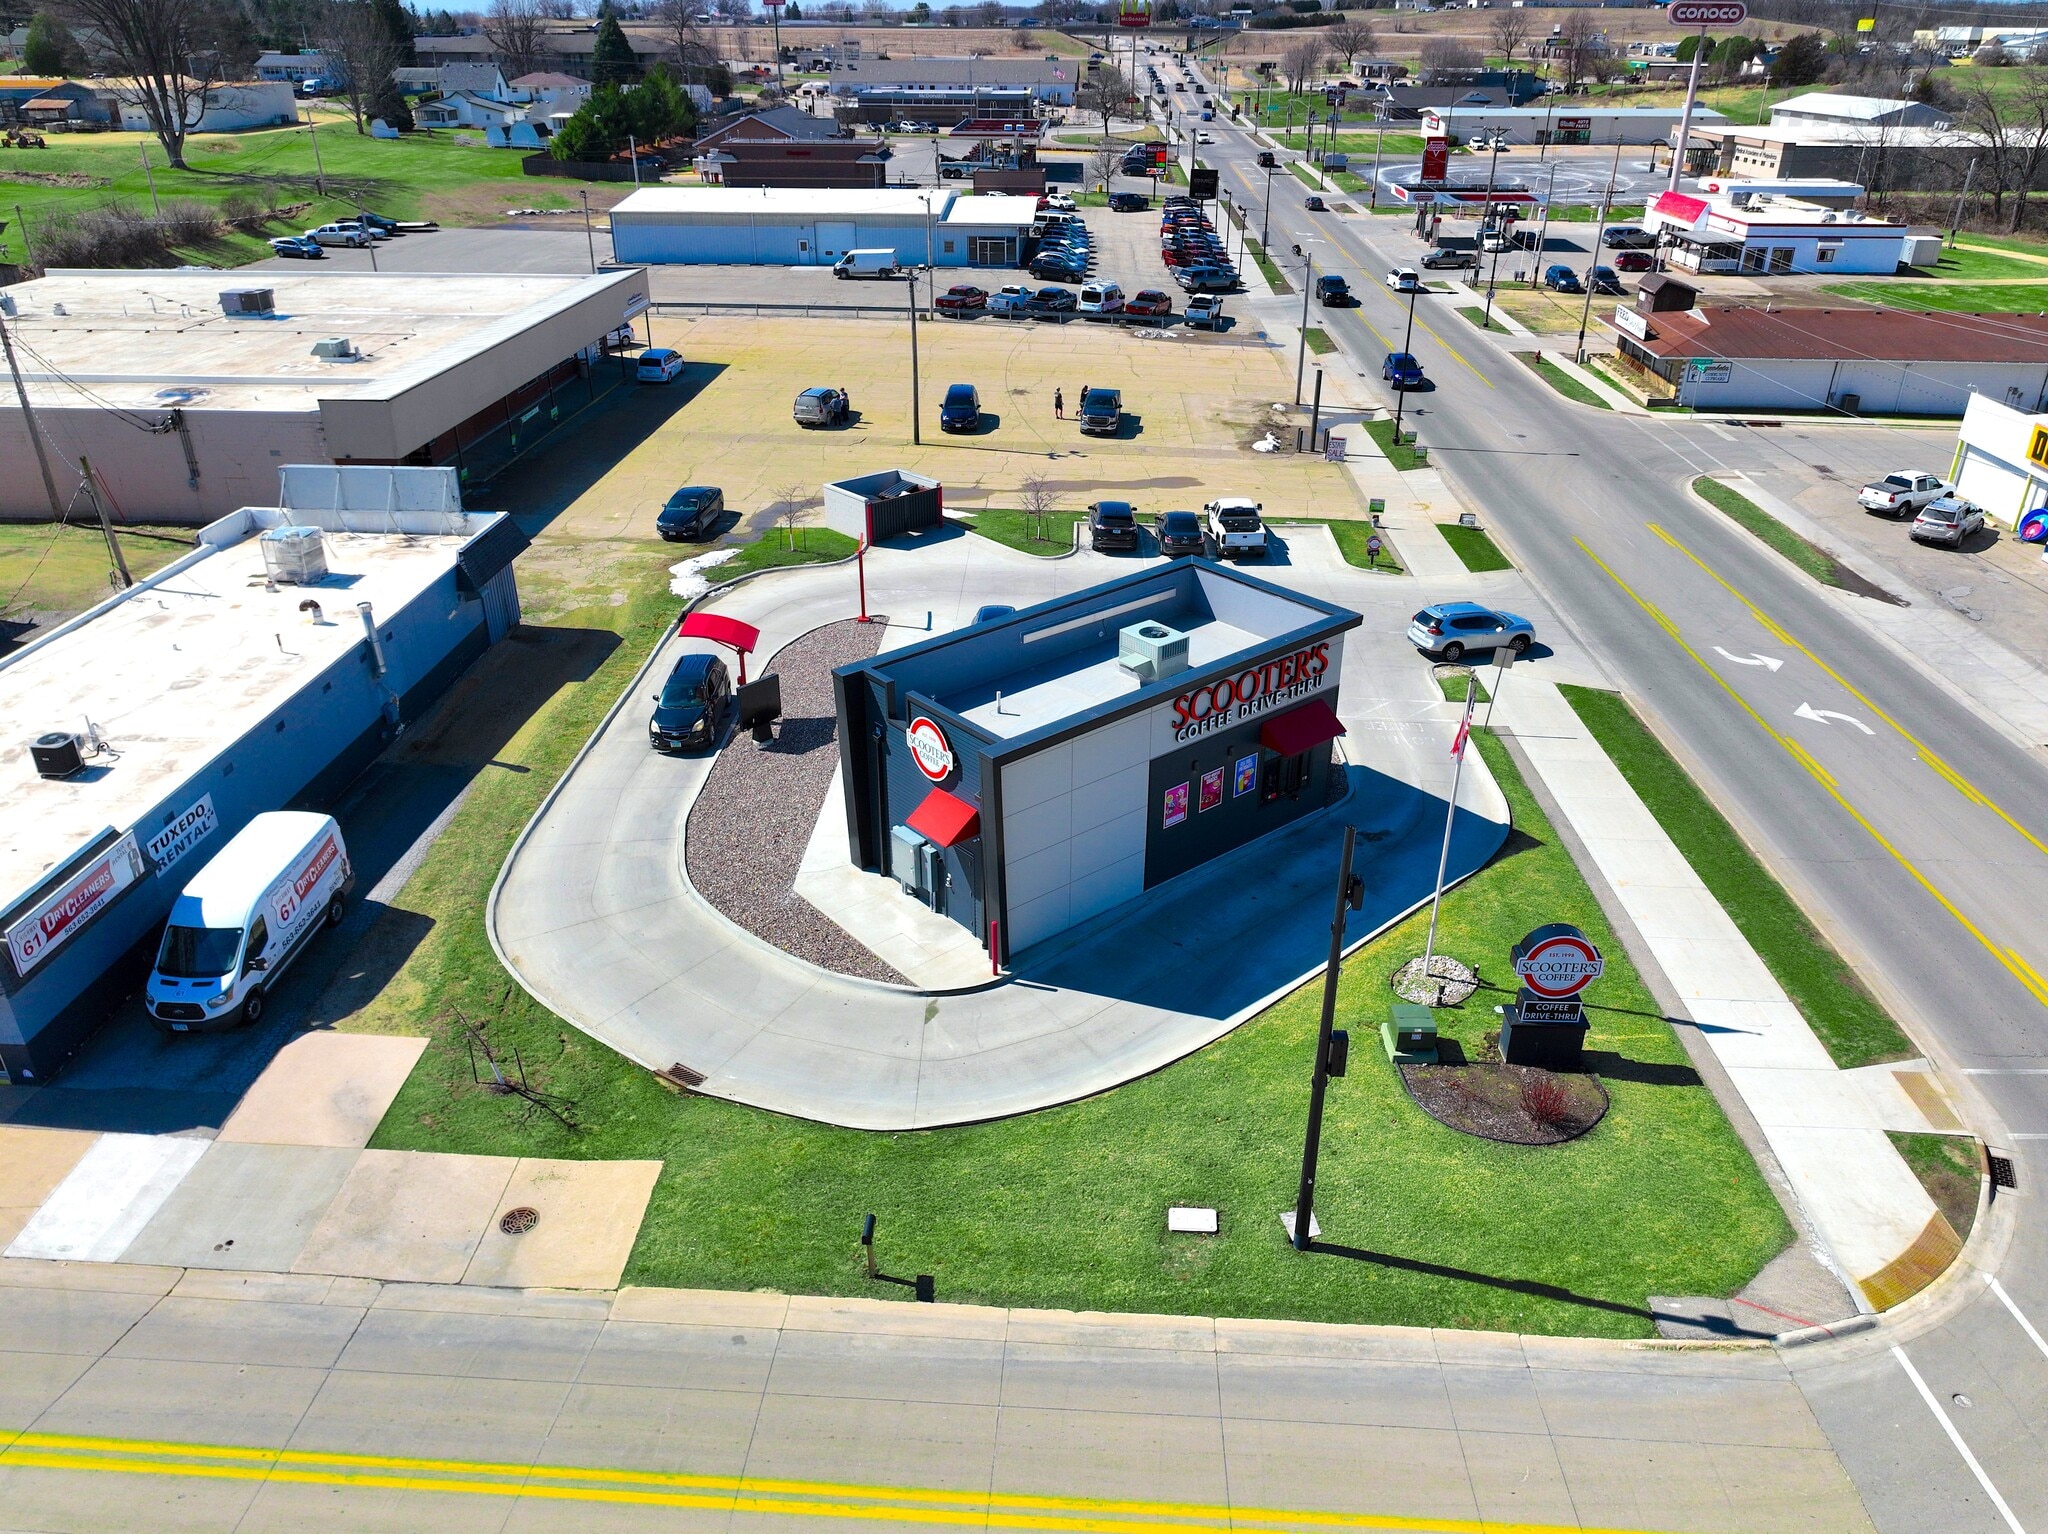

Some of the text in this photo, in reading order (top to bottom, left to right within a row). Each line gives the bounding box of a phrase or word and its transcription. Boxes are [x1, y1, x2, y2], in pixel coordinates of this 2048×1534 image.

[1327, 449, 1344, 457] SALE
[1329, 441, 1346, 449] ESTATE
[1172, 642, 1329, 729] SCOOTER'S
[1176, 674, 1325, 743] COFFEE DRIVE-THRU
[909, 734, 951, 765] SCOOTER'S
[920, 750, 940, 767] COFFEE
[150, 803, 205, 854] TUXEDO
[157, 820, 211, 873] RENTAL
[280, 896, 296, 921] 61
[23, 932, 42, 956] 61
[1521, 962, 1598, 973] SCOOTER'S
[1538, 973, 1576, 981] COFFEE
[1524, 1012, 1577, 1020] DRIVE-THRU
[1536, 1003, 1569, 1011] COFFEE
